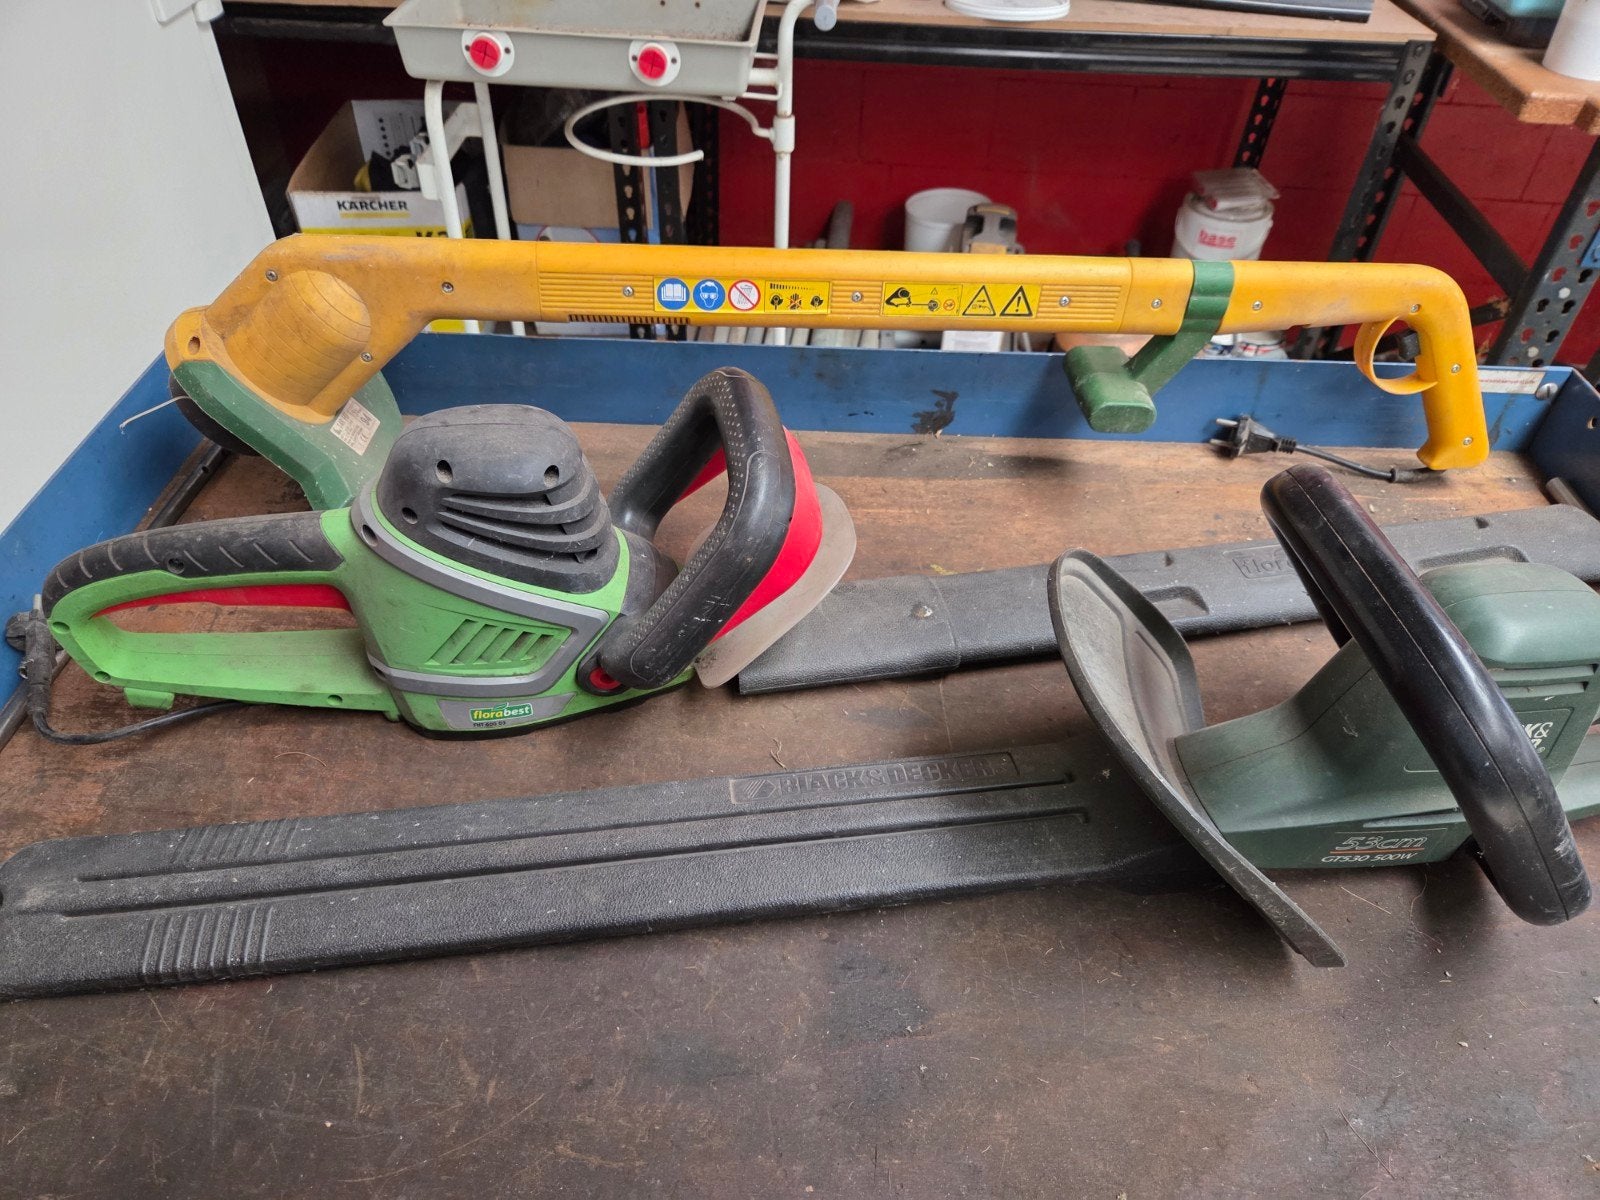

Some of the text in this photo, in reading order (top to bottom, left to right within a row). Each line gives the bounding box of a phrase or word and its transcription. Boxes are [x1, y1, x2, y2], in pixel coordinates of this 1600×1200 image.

[473, 706, 531, 720] florabest
[1335, 836, 1427, 851] 53cm
[1321, 852, 1418, 863] GT530 500W
